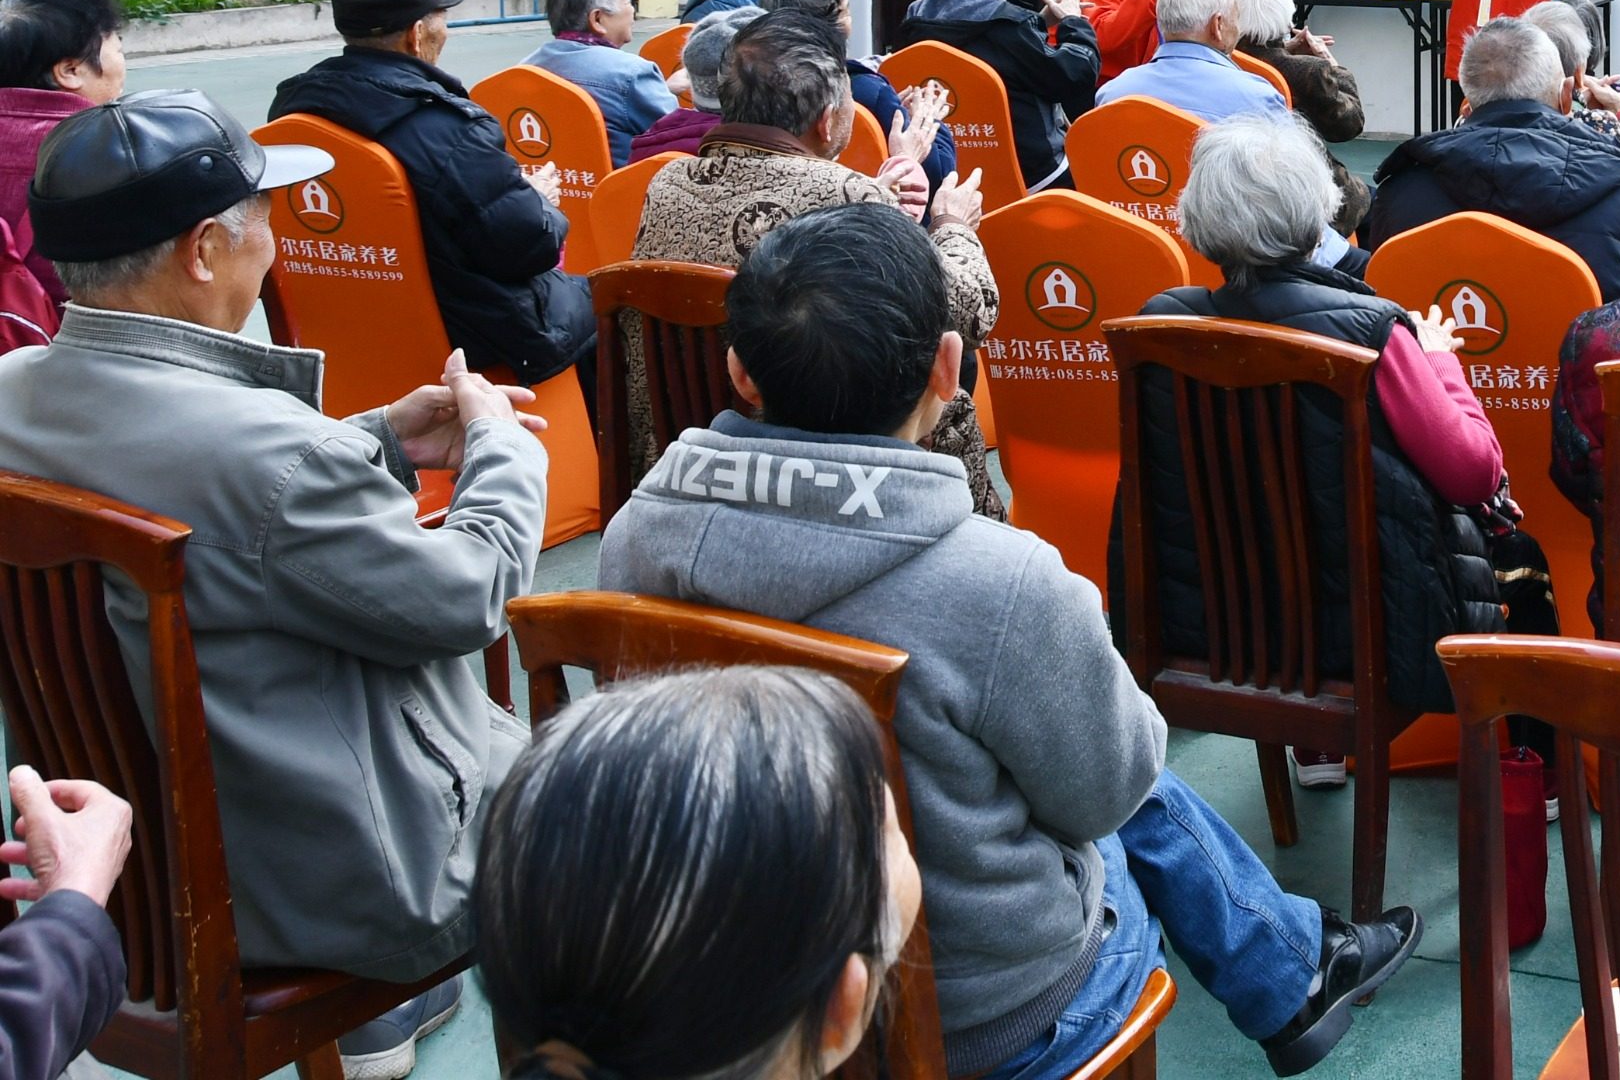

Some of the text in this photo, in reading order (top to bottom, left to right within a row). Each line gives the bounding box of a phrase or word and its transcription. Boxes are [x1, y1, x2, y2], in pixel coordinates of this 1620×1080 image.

[981, 337, 1111, 363] 康尔乐居家
